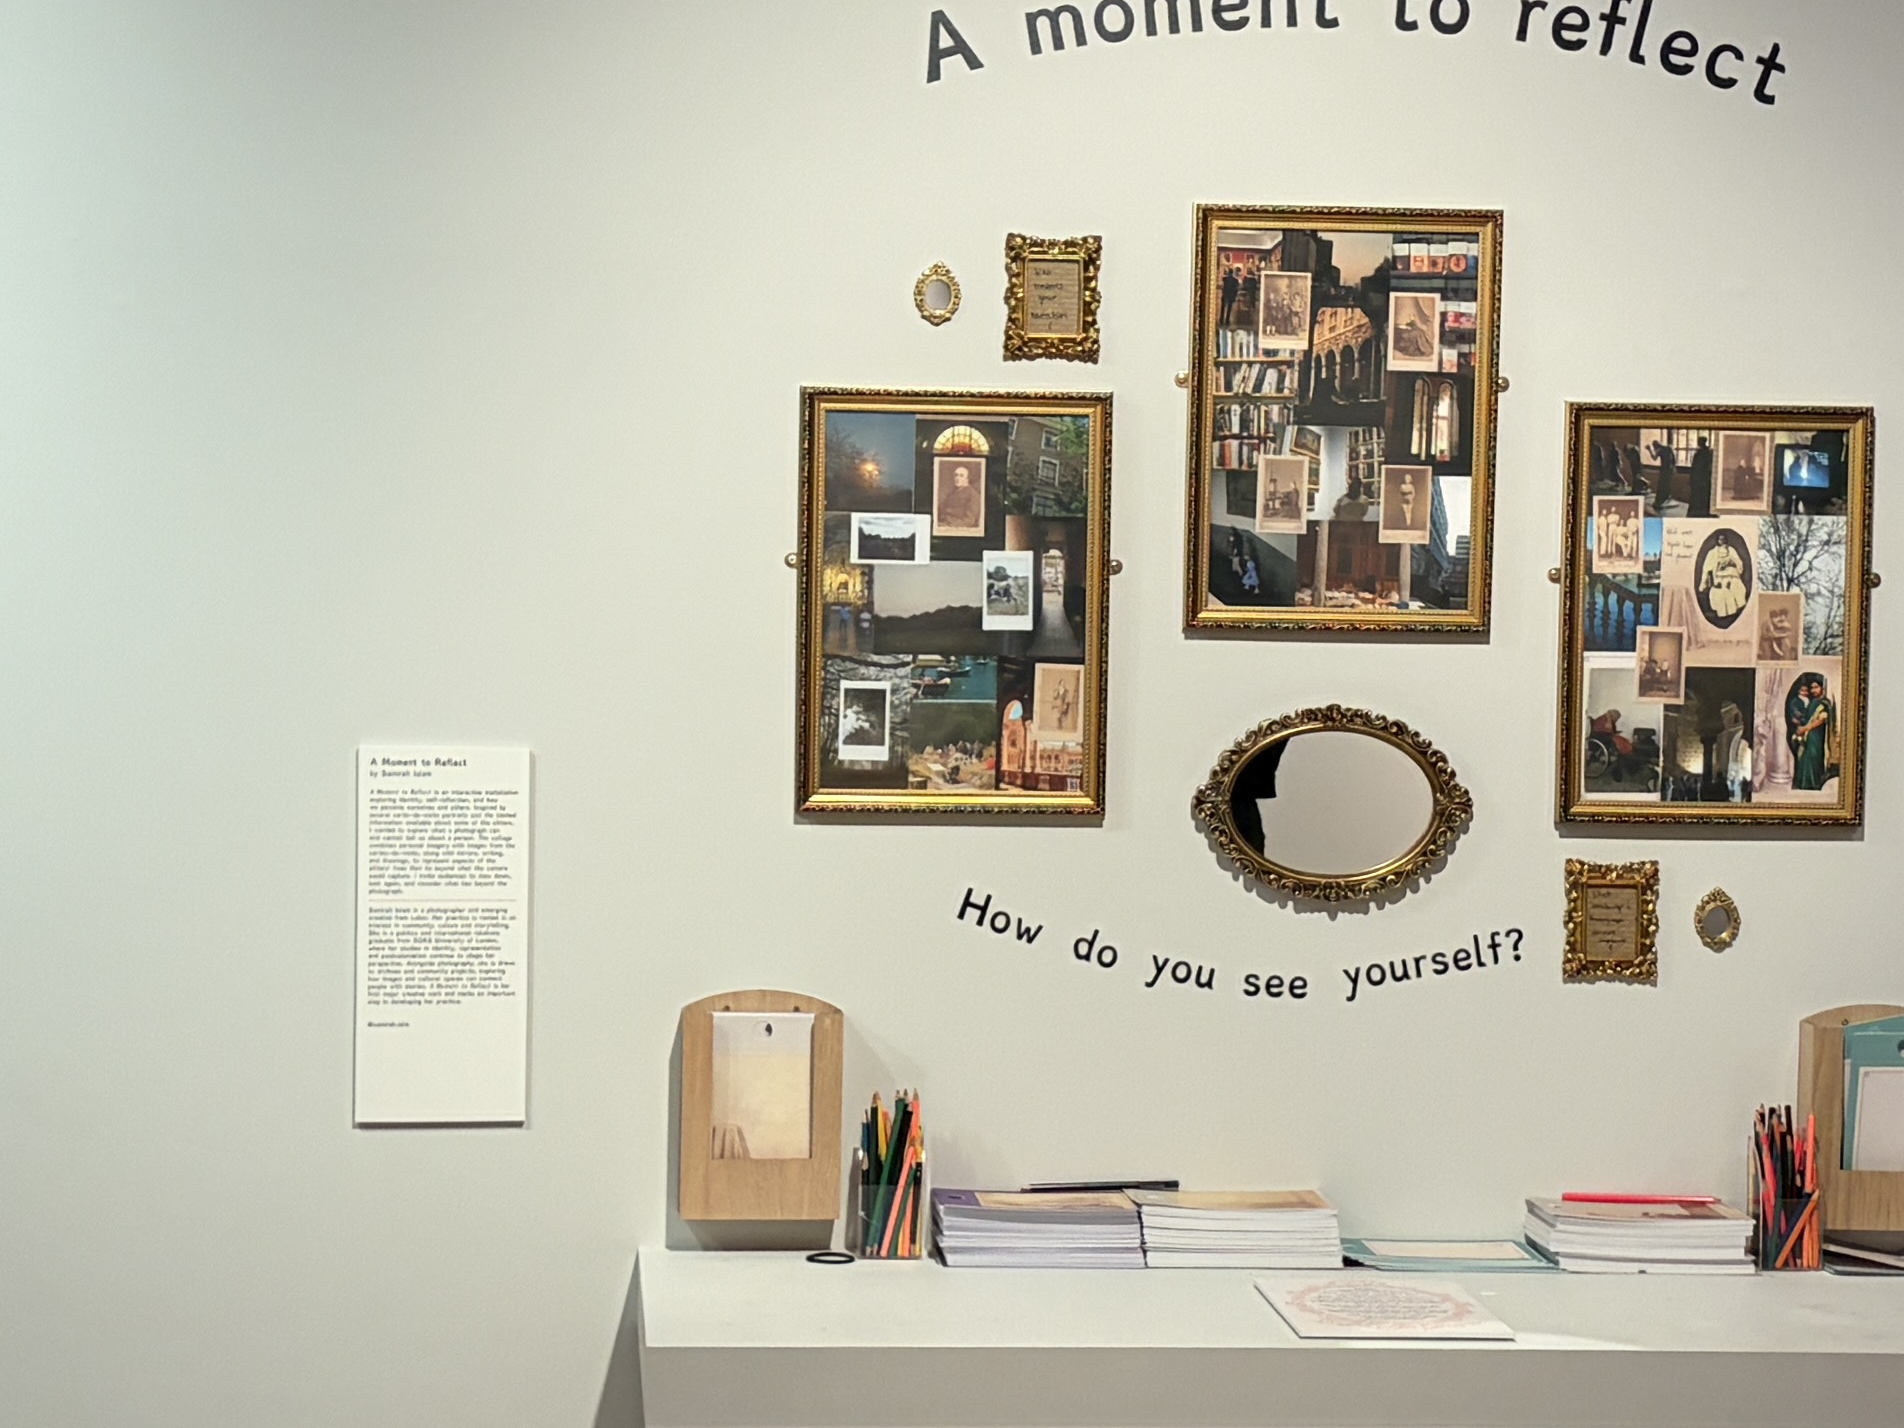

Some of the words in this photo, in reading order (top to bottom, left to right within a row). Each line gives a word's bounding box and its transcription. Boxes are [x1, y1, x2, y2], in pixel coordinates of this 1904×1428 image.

[926, 9, 985, 84] A
[957, 887, 1043, 944] How
[1073, 929, 1118, 969] do
[1144, 954, 1215, 989] you
[1243, 973, 1308, 1000] see
[1342, 928, 1525, 1003] yourself?
